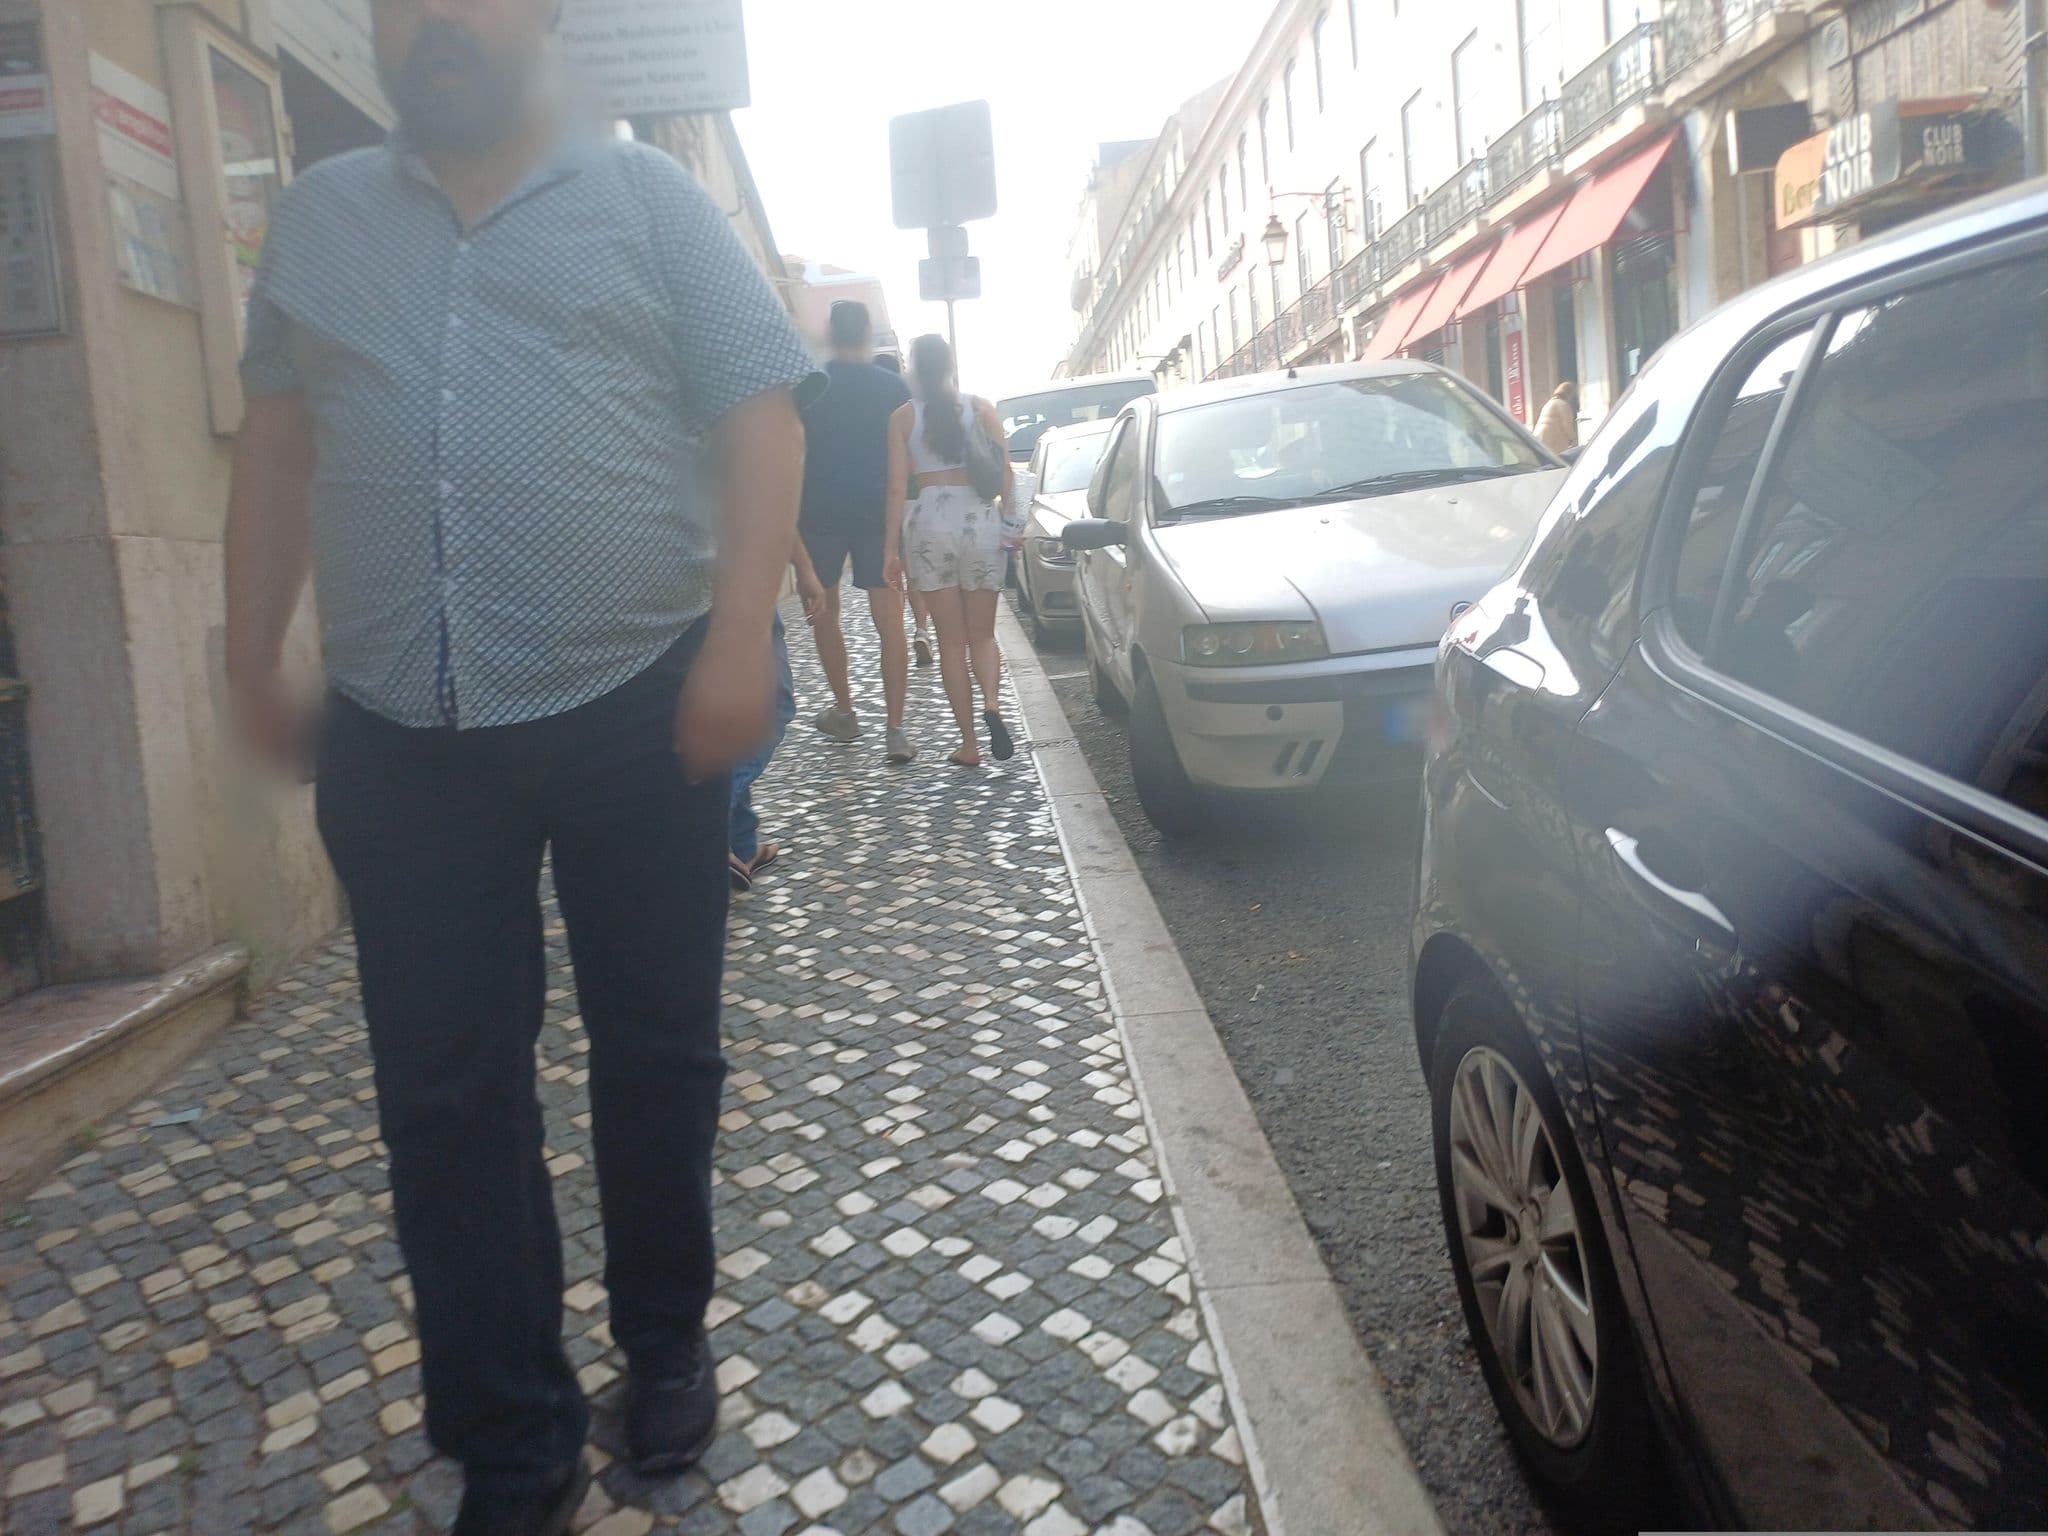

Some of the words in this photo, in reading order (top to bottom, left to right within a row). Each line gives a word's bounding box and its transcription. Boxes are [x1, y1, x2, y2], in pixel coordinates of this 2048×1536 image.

[1825, 113, 1872, 166] CLUB
[1922, 123, 1963, 148] CLUB
[1924, 144, 1964, 166] NOIR
[1825, 151, 1874, 204] NOIR
